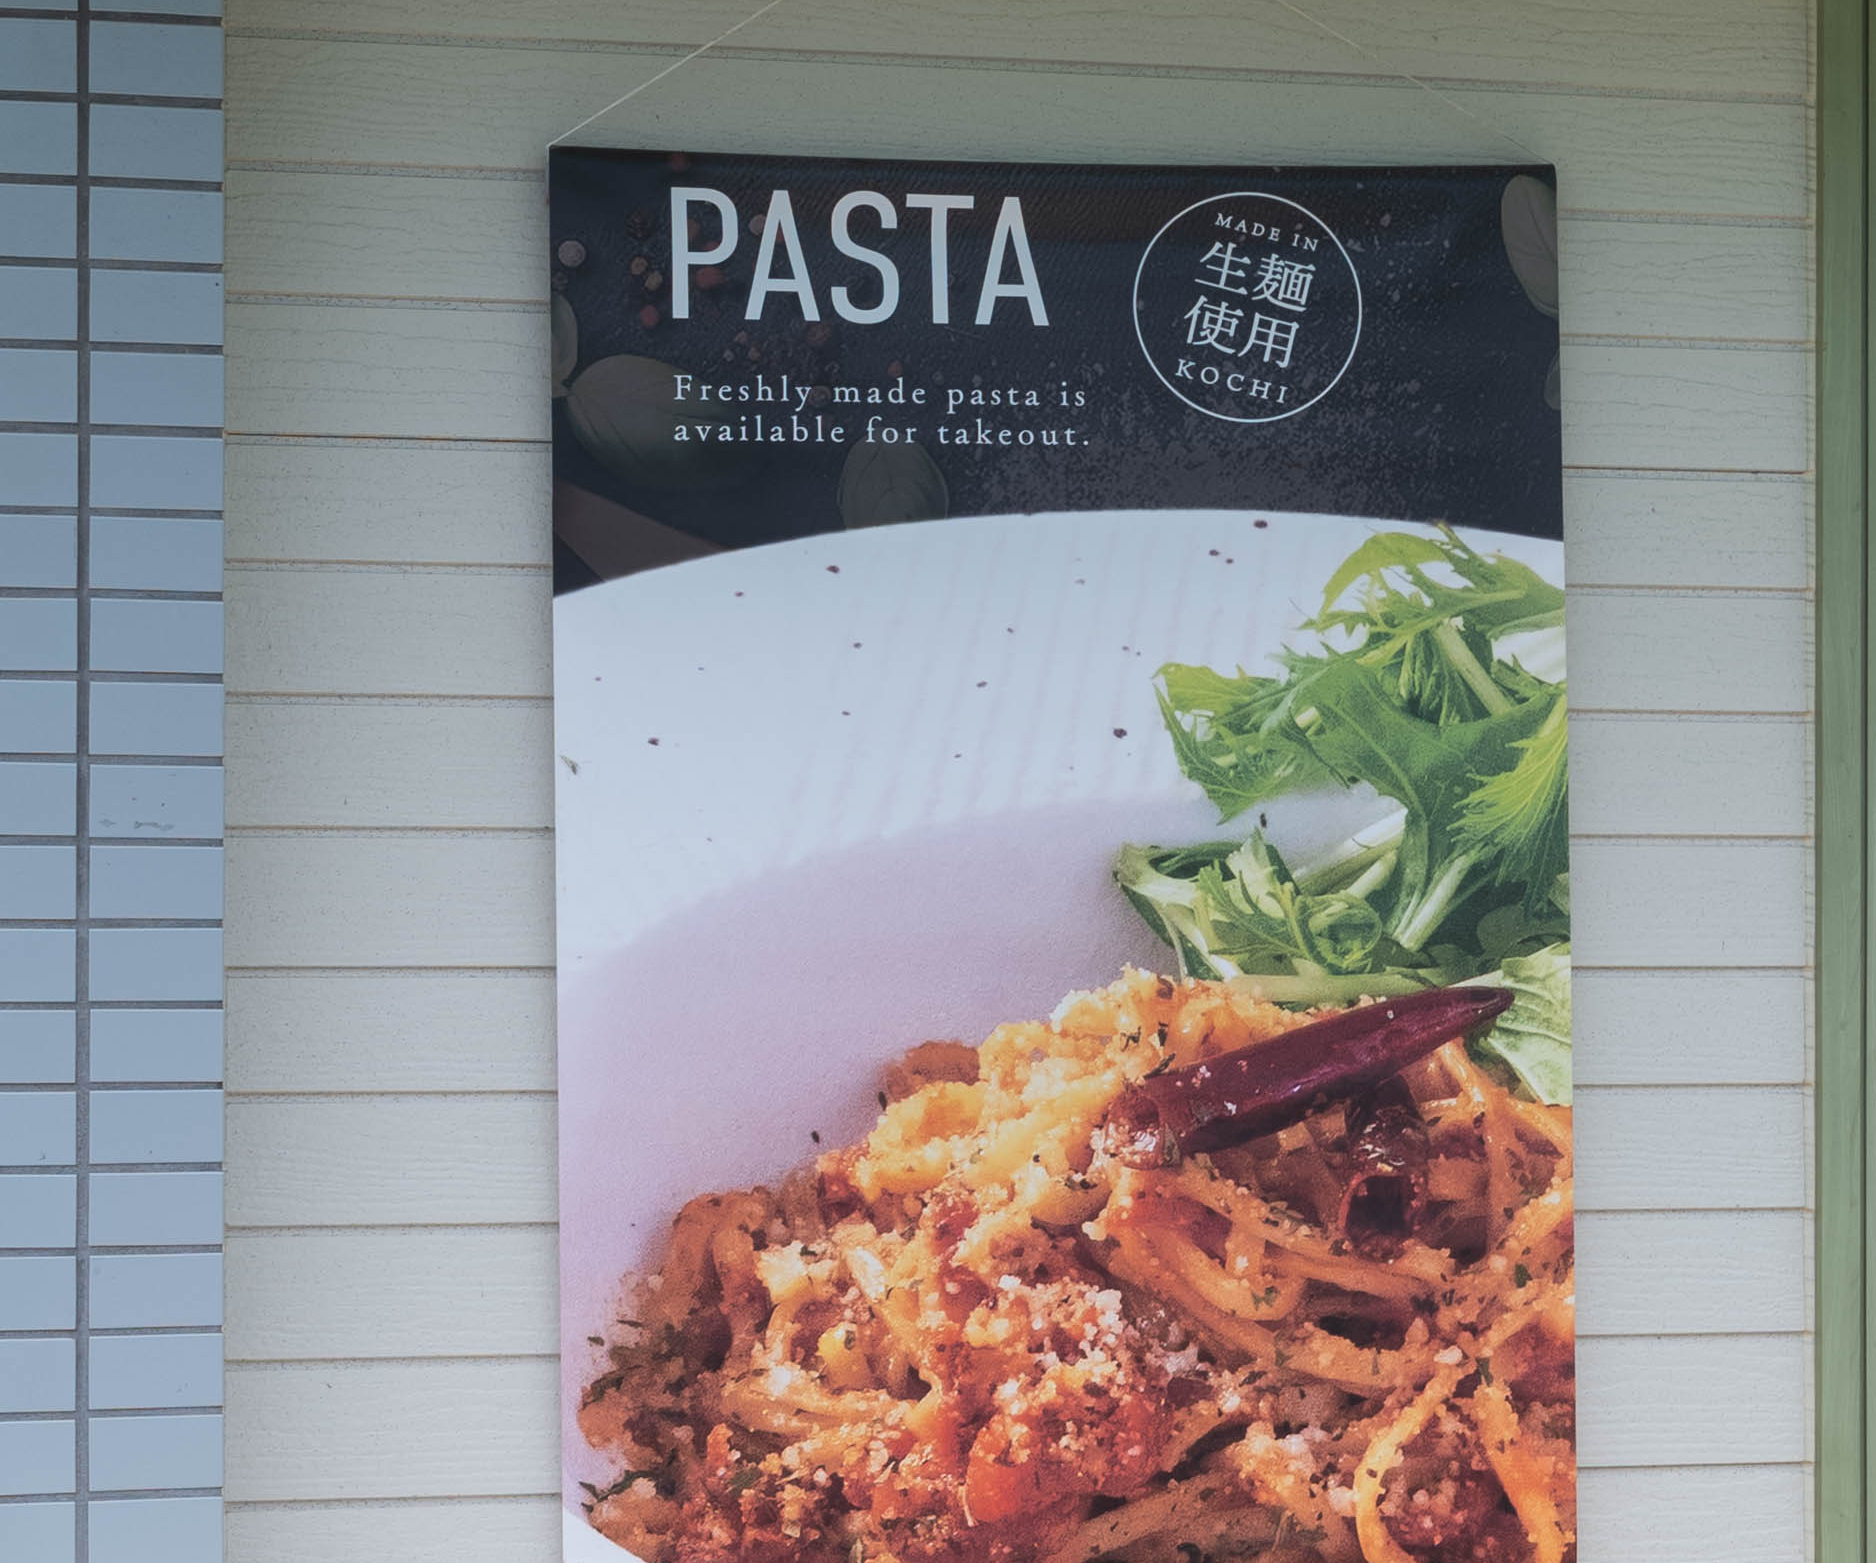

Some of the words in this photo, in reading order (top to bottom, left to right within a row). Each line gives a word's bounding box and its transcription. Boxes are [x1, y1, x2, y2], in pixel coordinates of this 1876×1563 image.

[1214, 212, 1281, 242] MADE
[1292, 233, 1319, 253] IN
[669, 185, 1050, 327] PASTA
[1194, 240, 1317, 312] 生麺
[1183, 294, 1300, 369] 使用
[673, 374, 812, 411] Freshly
[831, 378, 928, 406] made
[946, 384, 1041, 413] pasta
[1059, 381, 1087, 408] is
[1174, 358, 1289, 404] KOCHI
[673, 415, 846, 443] available
[865, 416, 917, 444] for
[938, 418, 1090, 446] takeout.
